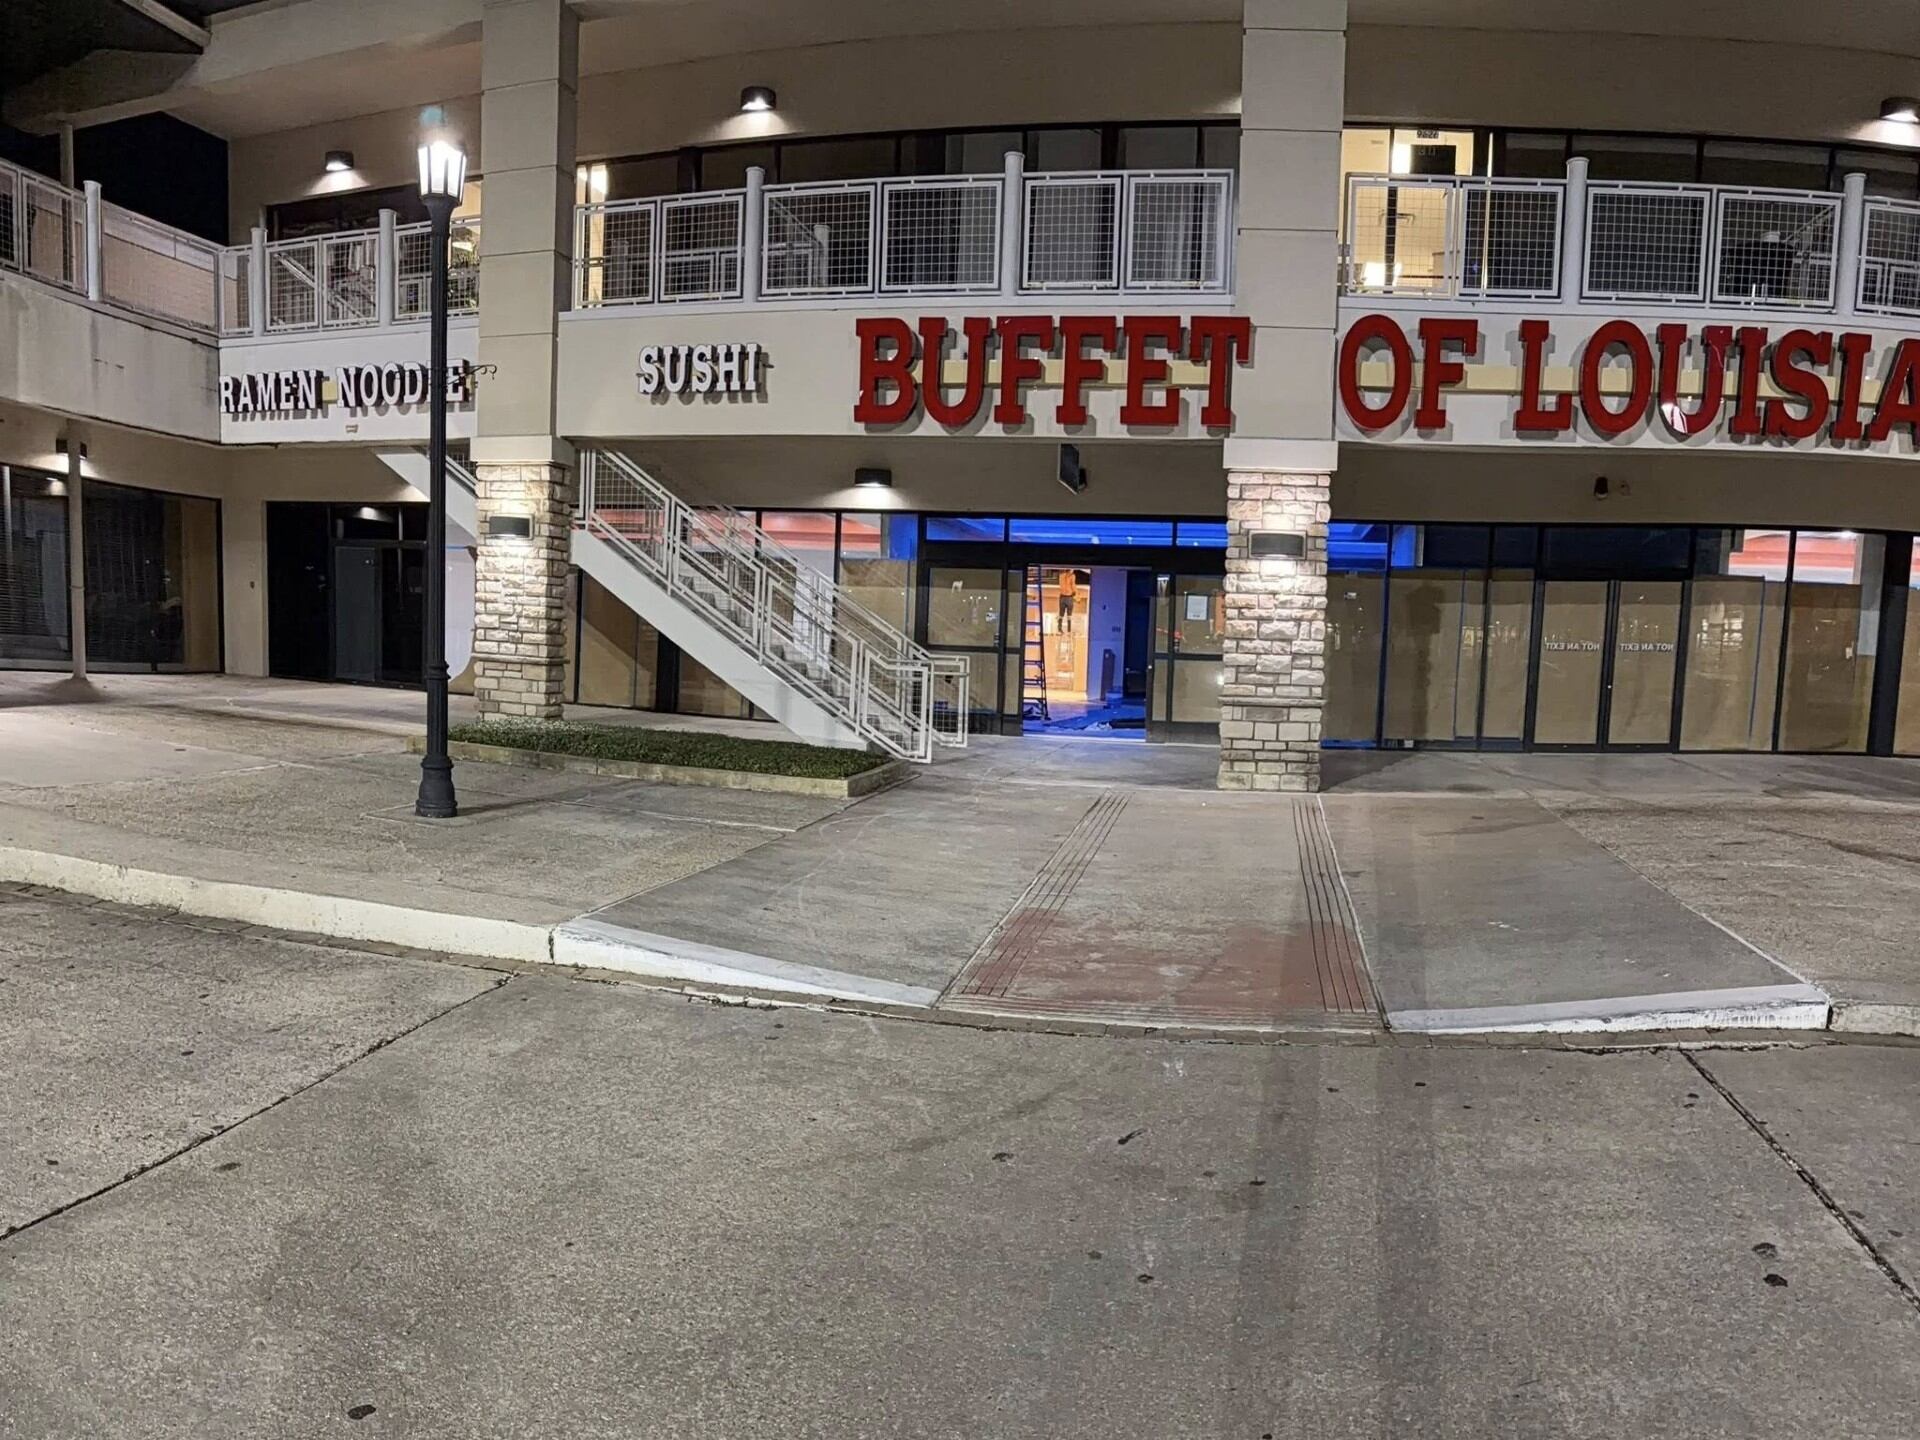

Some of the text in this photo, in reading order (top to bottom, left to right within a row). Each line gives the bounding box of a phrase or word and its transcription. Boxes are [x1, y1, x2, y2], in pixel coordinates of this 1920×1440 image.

[219, 359, 464, 413] RAMEN NOODE
[638, 343, 760, 393] SUSHI
[853, 314, 1920, 442] BUFFET OF LOUISIA
